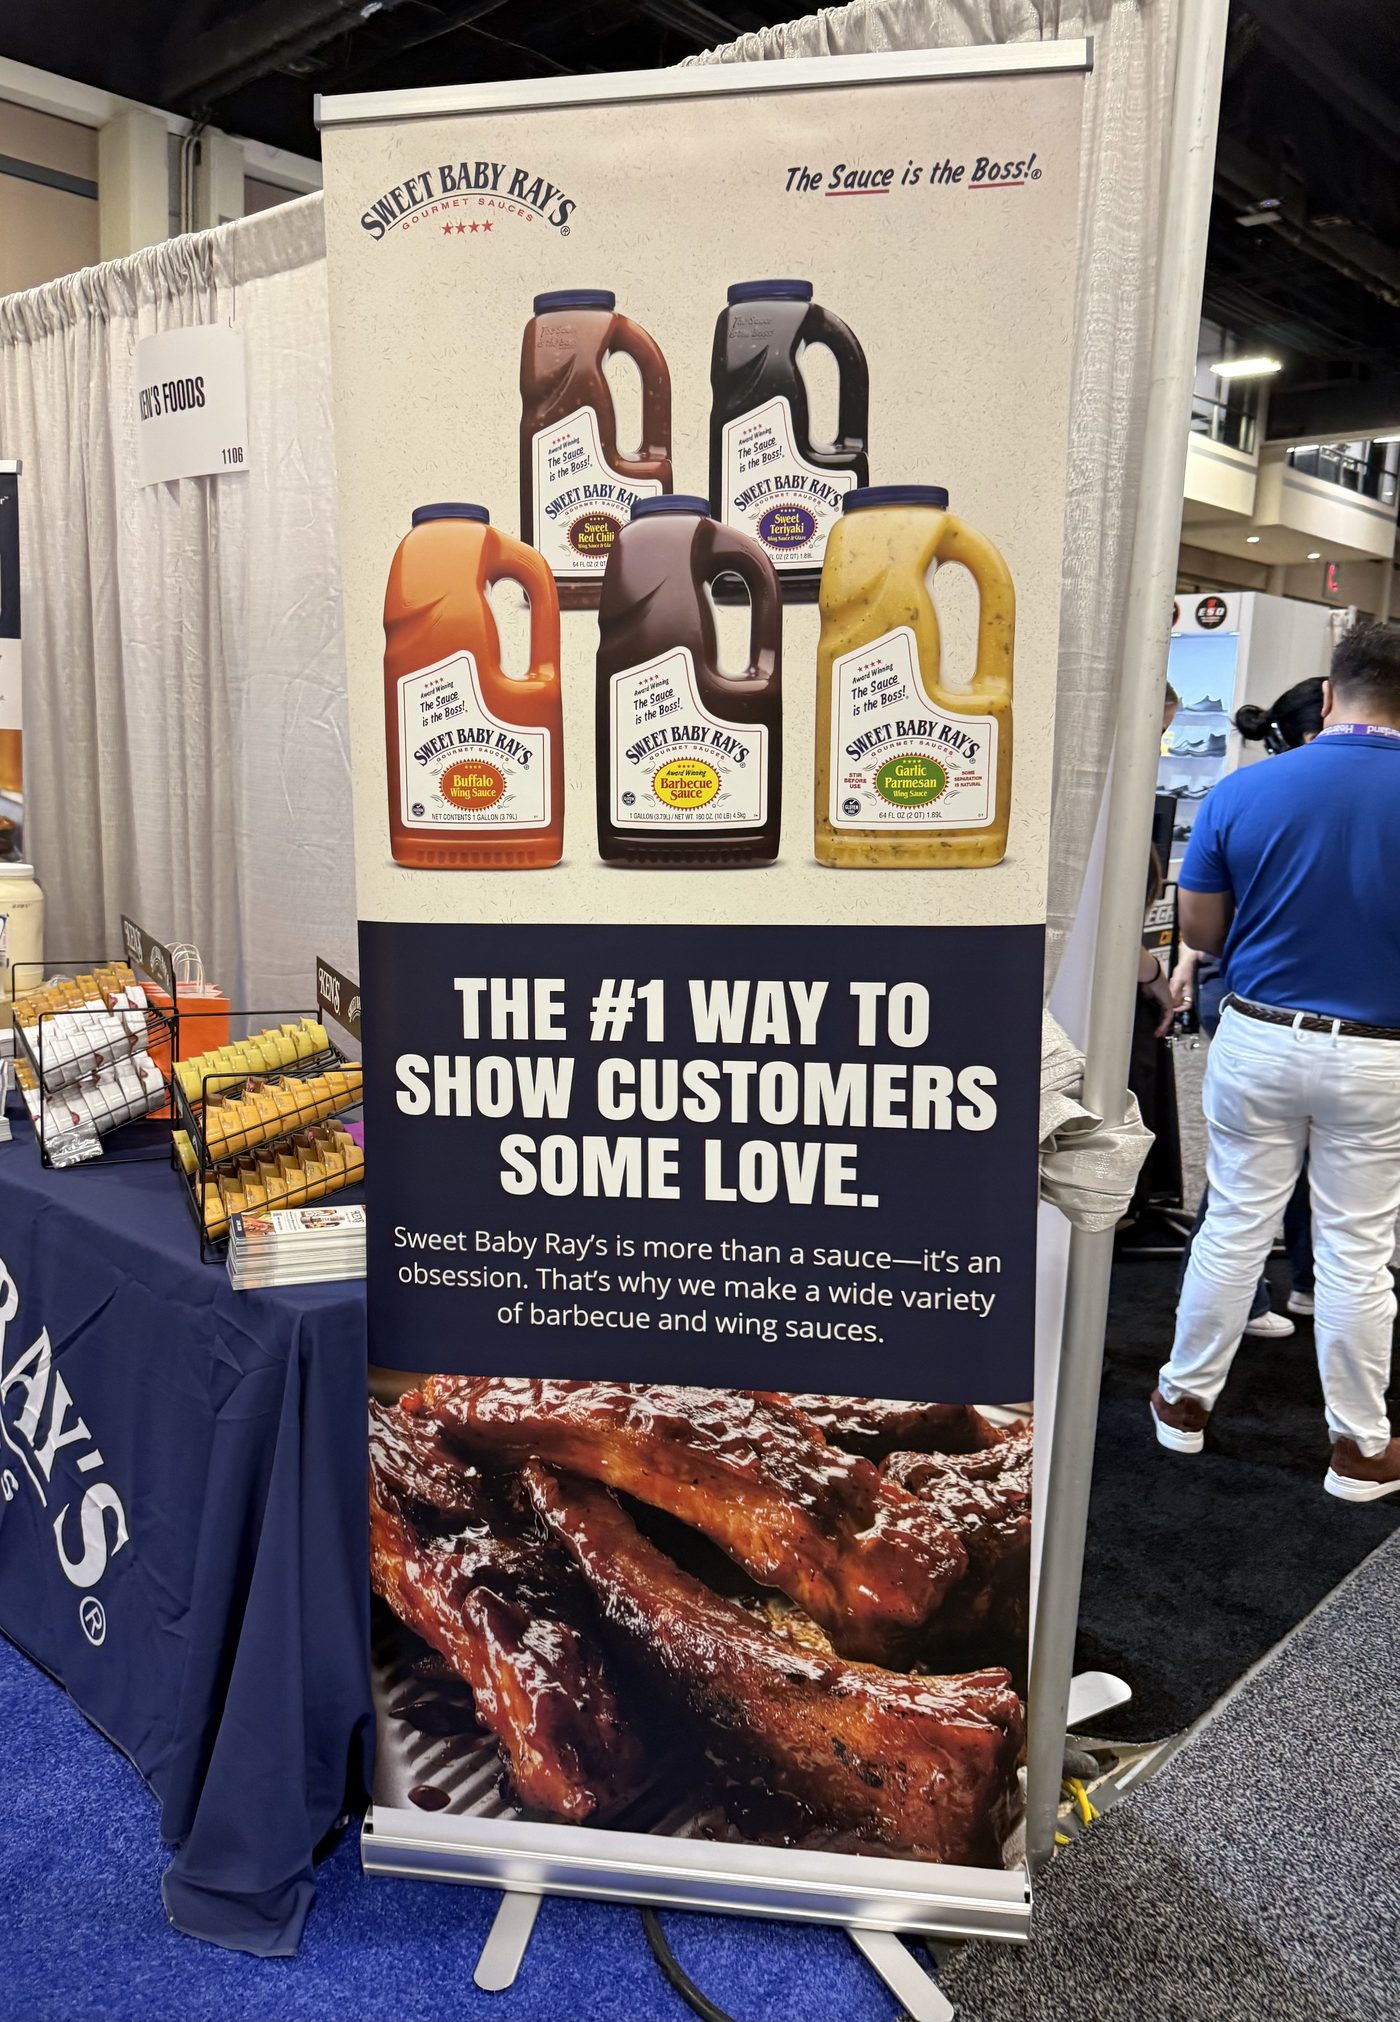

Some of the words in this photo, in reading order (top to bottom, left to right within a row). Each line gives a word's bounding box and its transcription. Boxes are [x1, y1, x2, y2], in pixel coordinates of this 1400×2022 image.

[785, 166, 823, 193] The
[828, 163, 895, 190] Sauce
[901, 160, 923, 186] is
[929, 158, 965, 185] the
[970, 152, 1037, 183] Boss!
[360, 171, 435, 241] SWEET
[438, 161, 507, 194] BABY
[507, 168, 577, 227] RAY'S
[402, 197, 469, 231] GOURMET
[478, 197, 534, 223] SAUCES
[162, 376, 206, 414] FOODS
[222, 446, 244, 465] 1106
[548, 457, 561, 469] The
[562, 447, 584, 462] Sauce
[738, 448, 751, 459] The
[753, 437, 776, 453] Sauce
[740, 463, 746, 473] is
[748, 458, 760, 469] the
[762, 445, 782, 463] Boss!
[549, 472, 556, 482] is
[557, 467, 569, 478] the
[570, 455, 590, 472] Boss!
[545, 487, 581, 520] SWEET
[583, 483, 616, 499] BABY
[734, 479, 772, 512] SWEET
[774, 475, 809, 490] BABY
[808, 479, 843, 508] RAY'S
[584, 522, 608, 533] Sweet
[770, 523, 804, 536] Teriyaki
[774, 513, 799, 524] Sweet
[578, 533, 594, 543] Red
[851, 686, 868, 700] The
[870, 675, 898, 693] Sauce
[852, 672, 870, 684] Award
[420, 701, 434, 713] The
[436, 691, 458, 707] Sauce
[633, 698, 648, 710] The
[650, 688, 674, 704] Sauce
[635, 714, 642, 725] is
[644, 709, 657, 722] the
[659, 697, 680, 716] Boss!
[853, 705, 861, 716] is
[864, 699, 878, 712] the
[880, 685, 906, 705] Boss!
[422, 717, 429, 727] is
[431, 711, 443, 724] the
[444, 700, 465, 718] Boss!
[413, 731, 455, 767] SWEET
[456, 727, 495, 744] BABY
[495, 732, 533, 766] RAY'S
[625, 728, 669, 766] SWEET
[671, 725, 710, 743] BABY
[711, 731, 750, 764] RAY'S
[649, 745, 688, 761] GOURMET
[845, 722, 892, 762] SWEET
[895, 719, 938, 737] BABY
[938, 724, 981, 759] RAY'S
[871, 740, 914, 757] GOURMET
[919, 740, 954, 756] SAUCES
[437, 747, 474, 762] GOURMET
[453, 774, 494, 788] Buffalo
[685, 770, 707, 778] Winning
[885, 777, 937, 788] Parmesan
[895, 764, 927, 776] Garlic
[450, 787, 471, 799] Wing
[472, 787, 496, 797] Sauce
[660, 778, 713, 789] Barbecue
[893, 790, 908, 799] Wing
[454, 977, 567, 1041] THE
[590, 978, 664, 1042] #1
[688, 979, 829, 1045] WAY
[850, 981, 930, 1048] TO
[395, 1053, 575, 1119] SHOW
[597, 1057, 998, 1132] CUSTOMERS
[499, 1133, 680, 1200] SOME
[704, 1138, 879, 1208] LOVE.
[394, 1226, 468, 1252] Sweet
[475, 1230, 538, 1260] Baby
[545, 1232, 608, 1262] Ray's
[616, 1234, 635, 1257] is
[643, 1240, 713, 1261] more
[719, 1238, 781, 1264] than
[789, 1247, 804, 1265] a
[813, 1248, 960, 1273] sauce—it's
[967, 1255, 1001, 1274] an
[398, 1261, 528, 1290] obsession.
[535, 1267, 611, 1292] That's
[617, 1270, 672, 1301] why
[677, 1278, 716, 1297] we
[724, 1276, 797, 1301] make
[805, 1284, 820, 1302] a
[828, 1281, 894, 1307] wide
[900, 1287, 996, 1318] variety
[497, 1301, 524, 1324] of
[530, 1302, 651, 1330] barbecue
[658, 1309, 707, 1333] and
[714, 1311, 778, 1343] wing
[785, 1320, 884, 1344] sauces.
